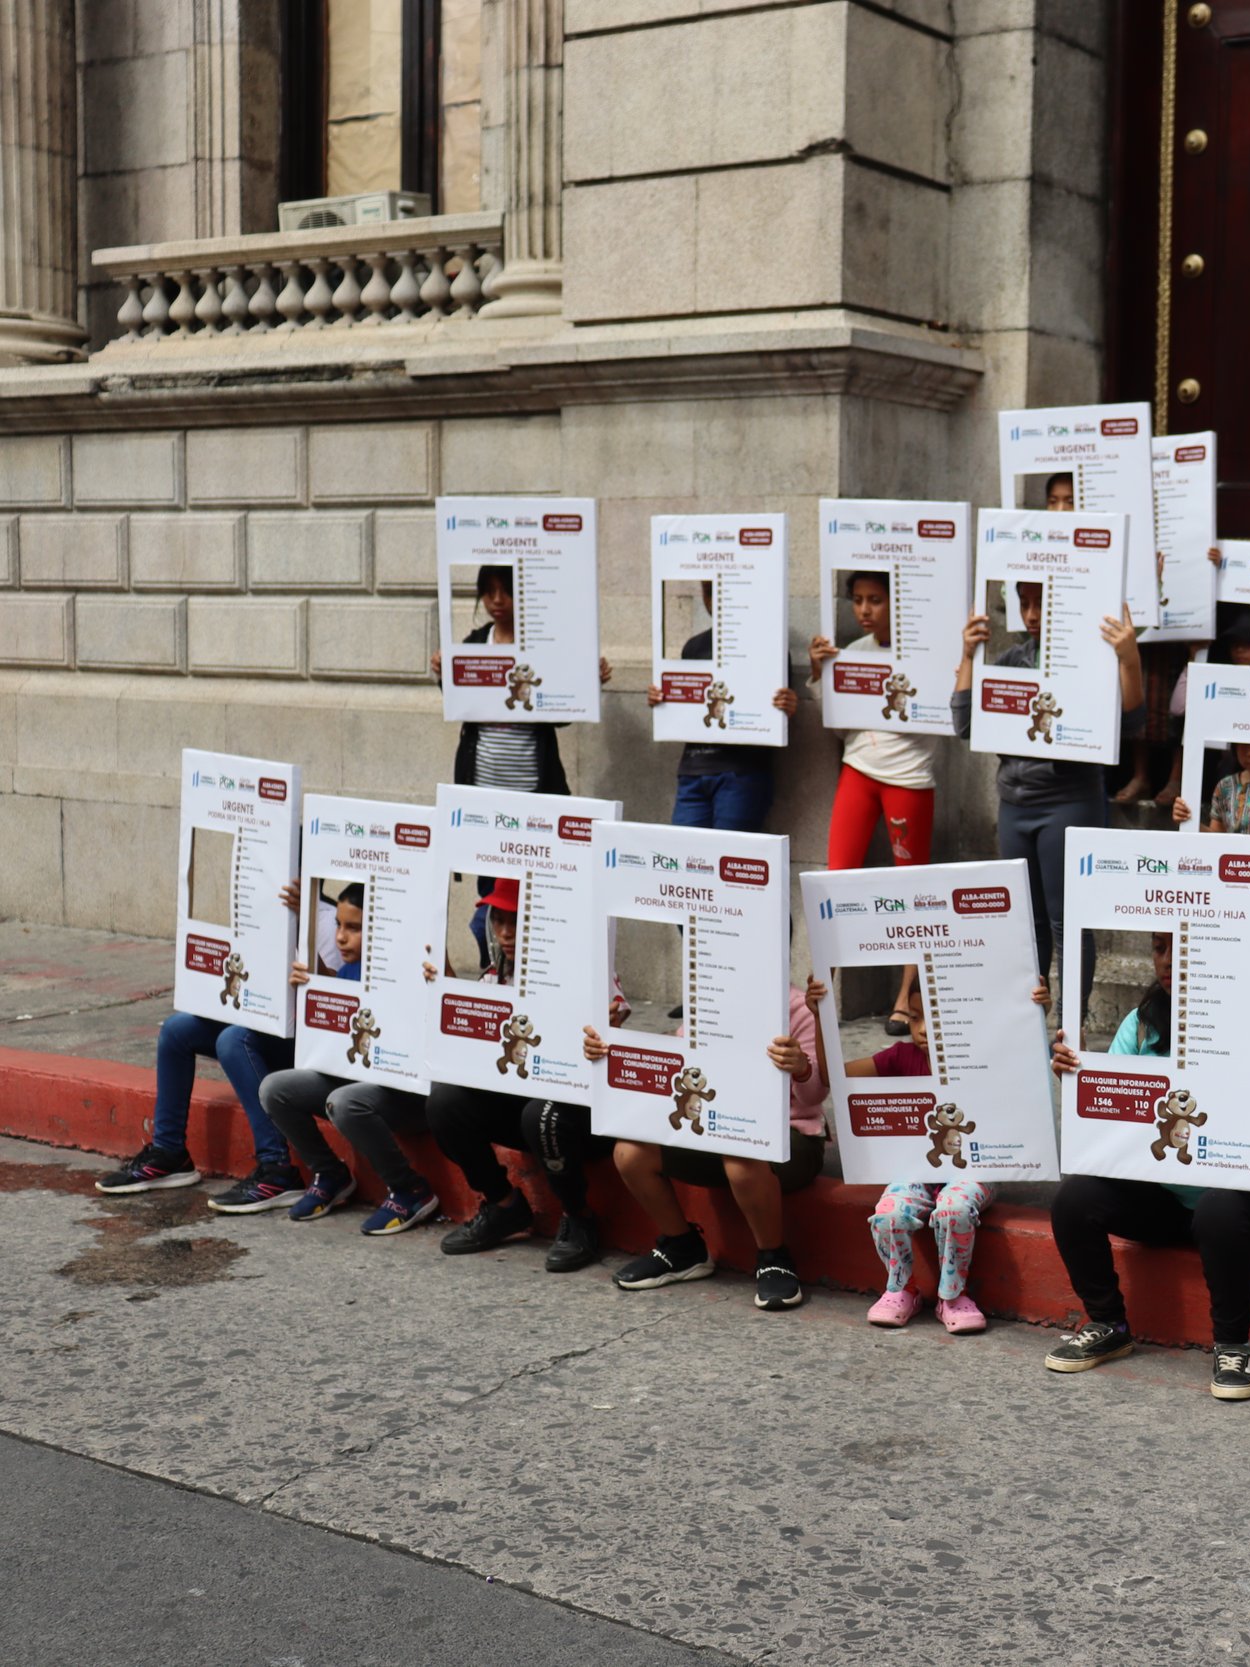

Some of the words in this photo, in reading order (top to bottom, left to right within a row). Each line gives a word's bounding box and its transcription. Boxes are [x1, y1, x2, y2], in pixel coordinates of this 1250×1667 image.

[1054, 443, 1096, 454] URGENTE
[492, 537, 537, 547] URGENTE
[871, 543, 913, 553] URGENTE
[697, 552, 734, 562] URGENTE
[1026, 552, 1068, 563] URGENTE
[222, 800, 254, 815] URGENTE
[349, 847, 389, 863] URGENTE
[499, 841, 551, 858] URGENTE
[652, 854, 678, 870] PGN
[726, 861, 765, 873] ALBA-KENETH
[1136, 858, 1168, 873] PGN
[1178, 855, 1202, 865] Alerta
[659, 883, 713, 902] URGENTE
[960, 891, 1005, 901] ALBA-KENETH
[1145, 889, 1211, 905] URGENTE
[635, 896, 665, 908] PODRIA
[667, 900, 683, 910] SER
[685, 902, 696, 911] TU
[699, 903, 717, 914] HIJO
[724, 906, 742, 917] HIJA
[873, 897, 905, 912] PGN
[1114, 905, 1151, 916] PODRIA
[1154, 906, 1174, 917] SER
[1176, 907, 1189, 917] TU
[1192, 908, 1215, 919] HIJO
[1223, 910, 1246, 920] HIJA
[885, 923, 950, 939] URGENTE
[859, 941, 895, 952] PODRIA
[896, 941, 916, 950] SER
[917, 940, 931, 949] TU
[933, 939, 956, 949] HIJO
[963, 938, 985, 948] HIJA
[611, 1049, 640, 1060] CUALQUIER
[642, 1053, 681, 1066] INFORMACIÓN
[621, 1069, 637, 1079] 1546
[655, 1074, 667, 1084] 110
[1081, 1075, 1117, 1085] CUALQUIER
[1118, 1077, 1166, 1089] INFORMACIÓN
[1096, 1084, 1143, 1096] COMUNÍQUESE
[851, 1098, 886, 1106] CUALQUIER
[887, 1096, 933, 1105] INFORMACIÓN
[1093, 1097, 1112, 1106] 1546
[1134, 1100, 1149, 1110] 110
[865, 1116, 885, 1125] 1546
[905, 1116, 919, 1124] 110
